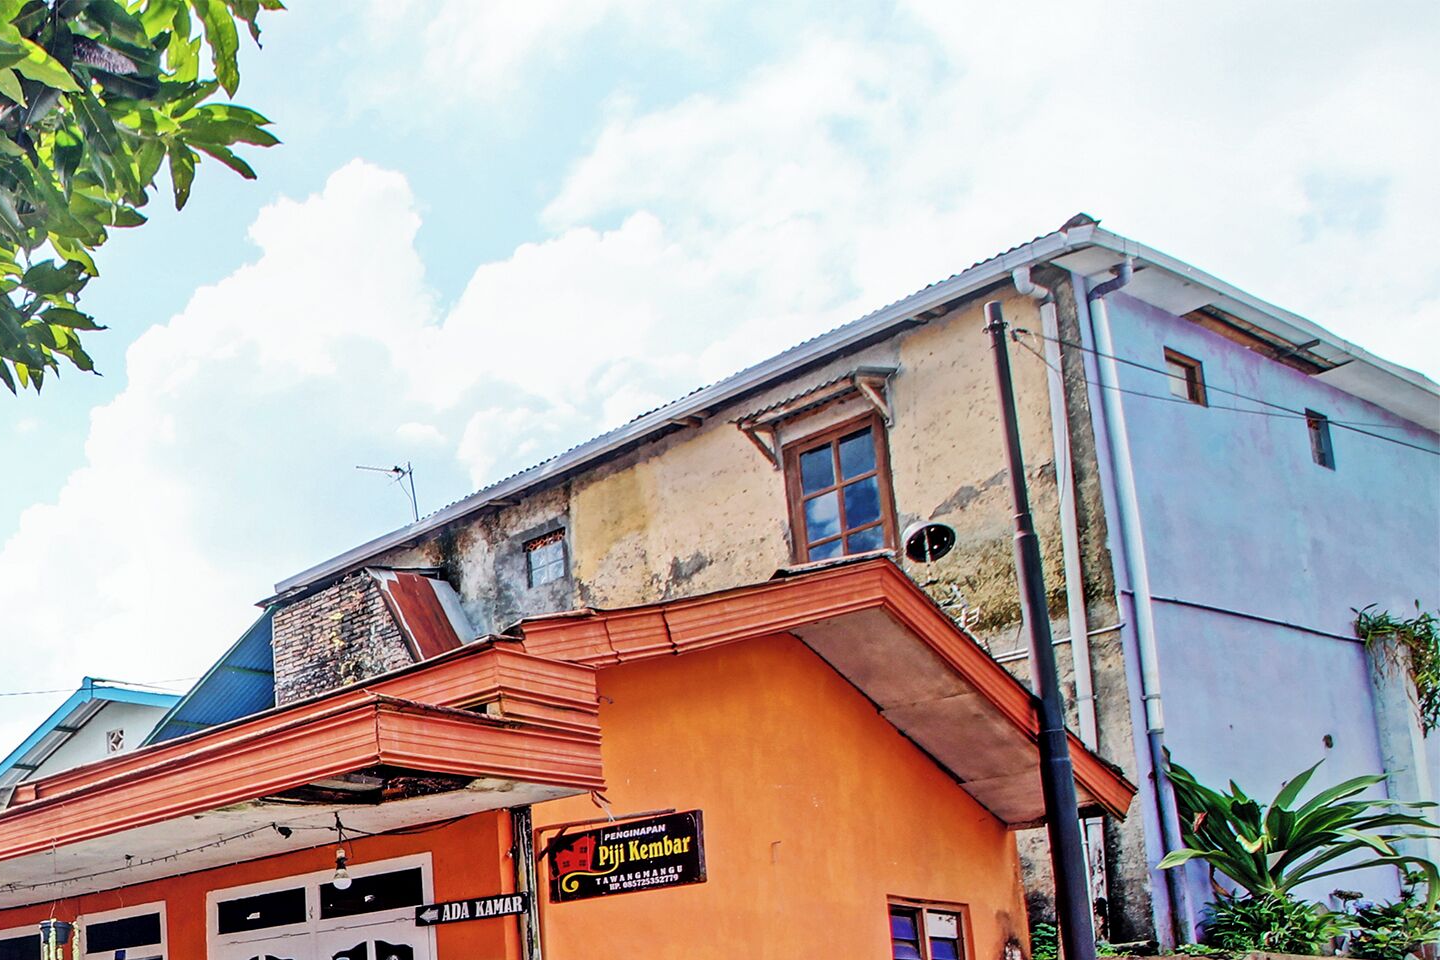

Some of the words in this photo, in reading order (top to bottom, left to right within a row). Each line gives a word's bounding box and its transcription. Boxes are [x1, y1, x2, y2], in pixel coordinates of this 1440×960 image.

[604, 824, 666, 841] PENGINAPAN
[598, 843, 625, 868] Piji
[628, 835, 691, 861] Kembar
[595, 865, 683, 885] TAWANGMANGU
[442, 902, 470, 921] ADA
[475, 896, 523, 917] KAMAR
